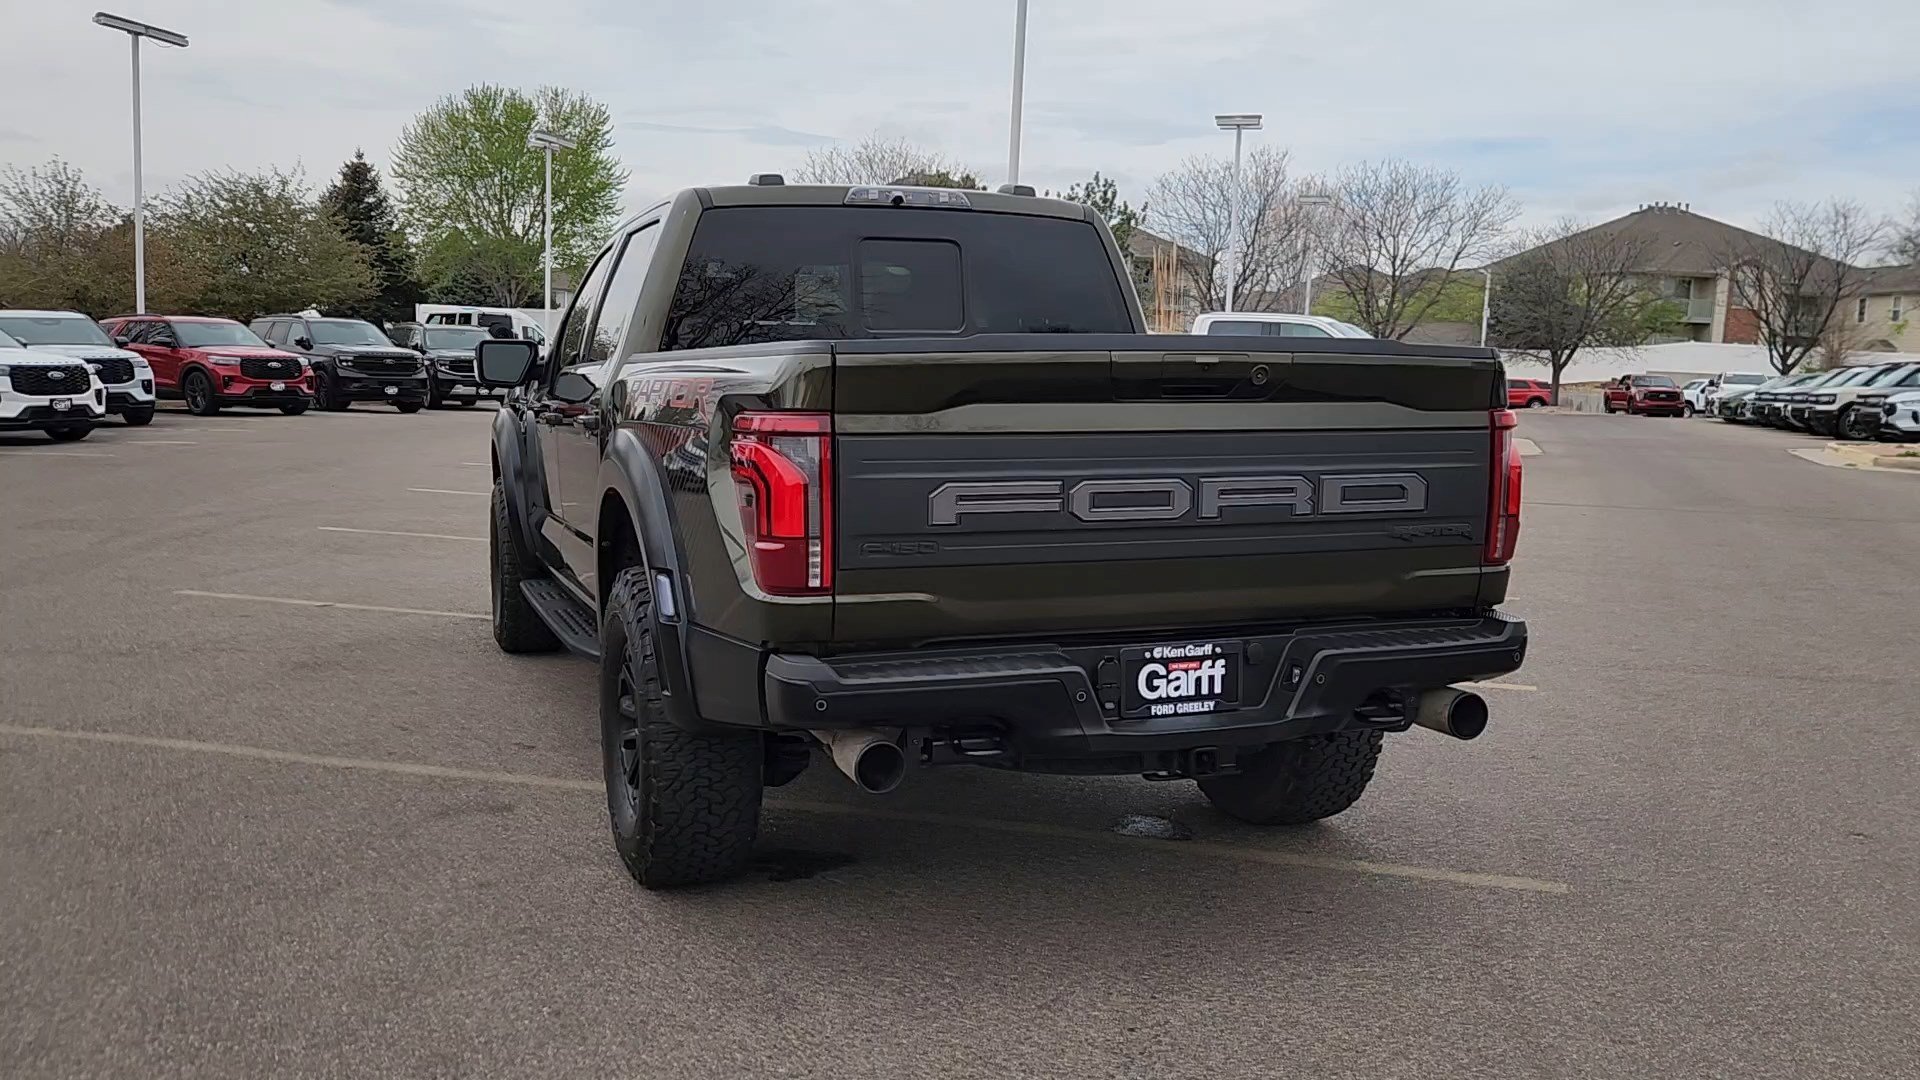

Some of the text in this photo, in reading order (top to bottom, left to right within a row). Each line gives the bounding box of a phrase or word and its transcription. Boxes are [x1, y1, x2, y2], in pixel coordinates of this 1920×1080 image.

[928, 473, 1428, 526] FORD
[1163, 644, 1213, 658] Ken Garff
[1138, 659, 1226, 700] Garff
[1151, 701, 1215, 715] FORD GREELEY
